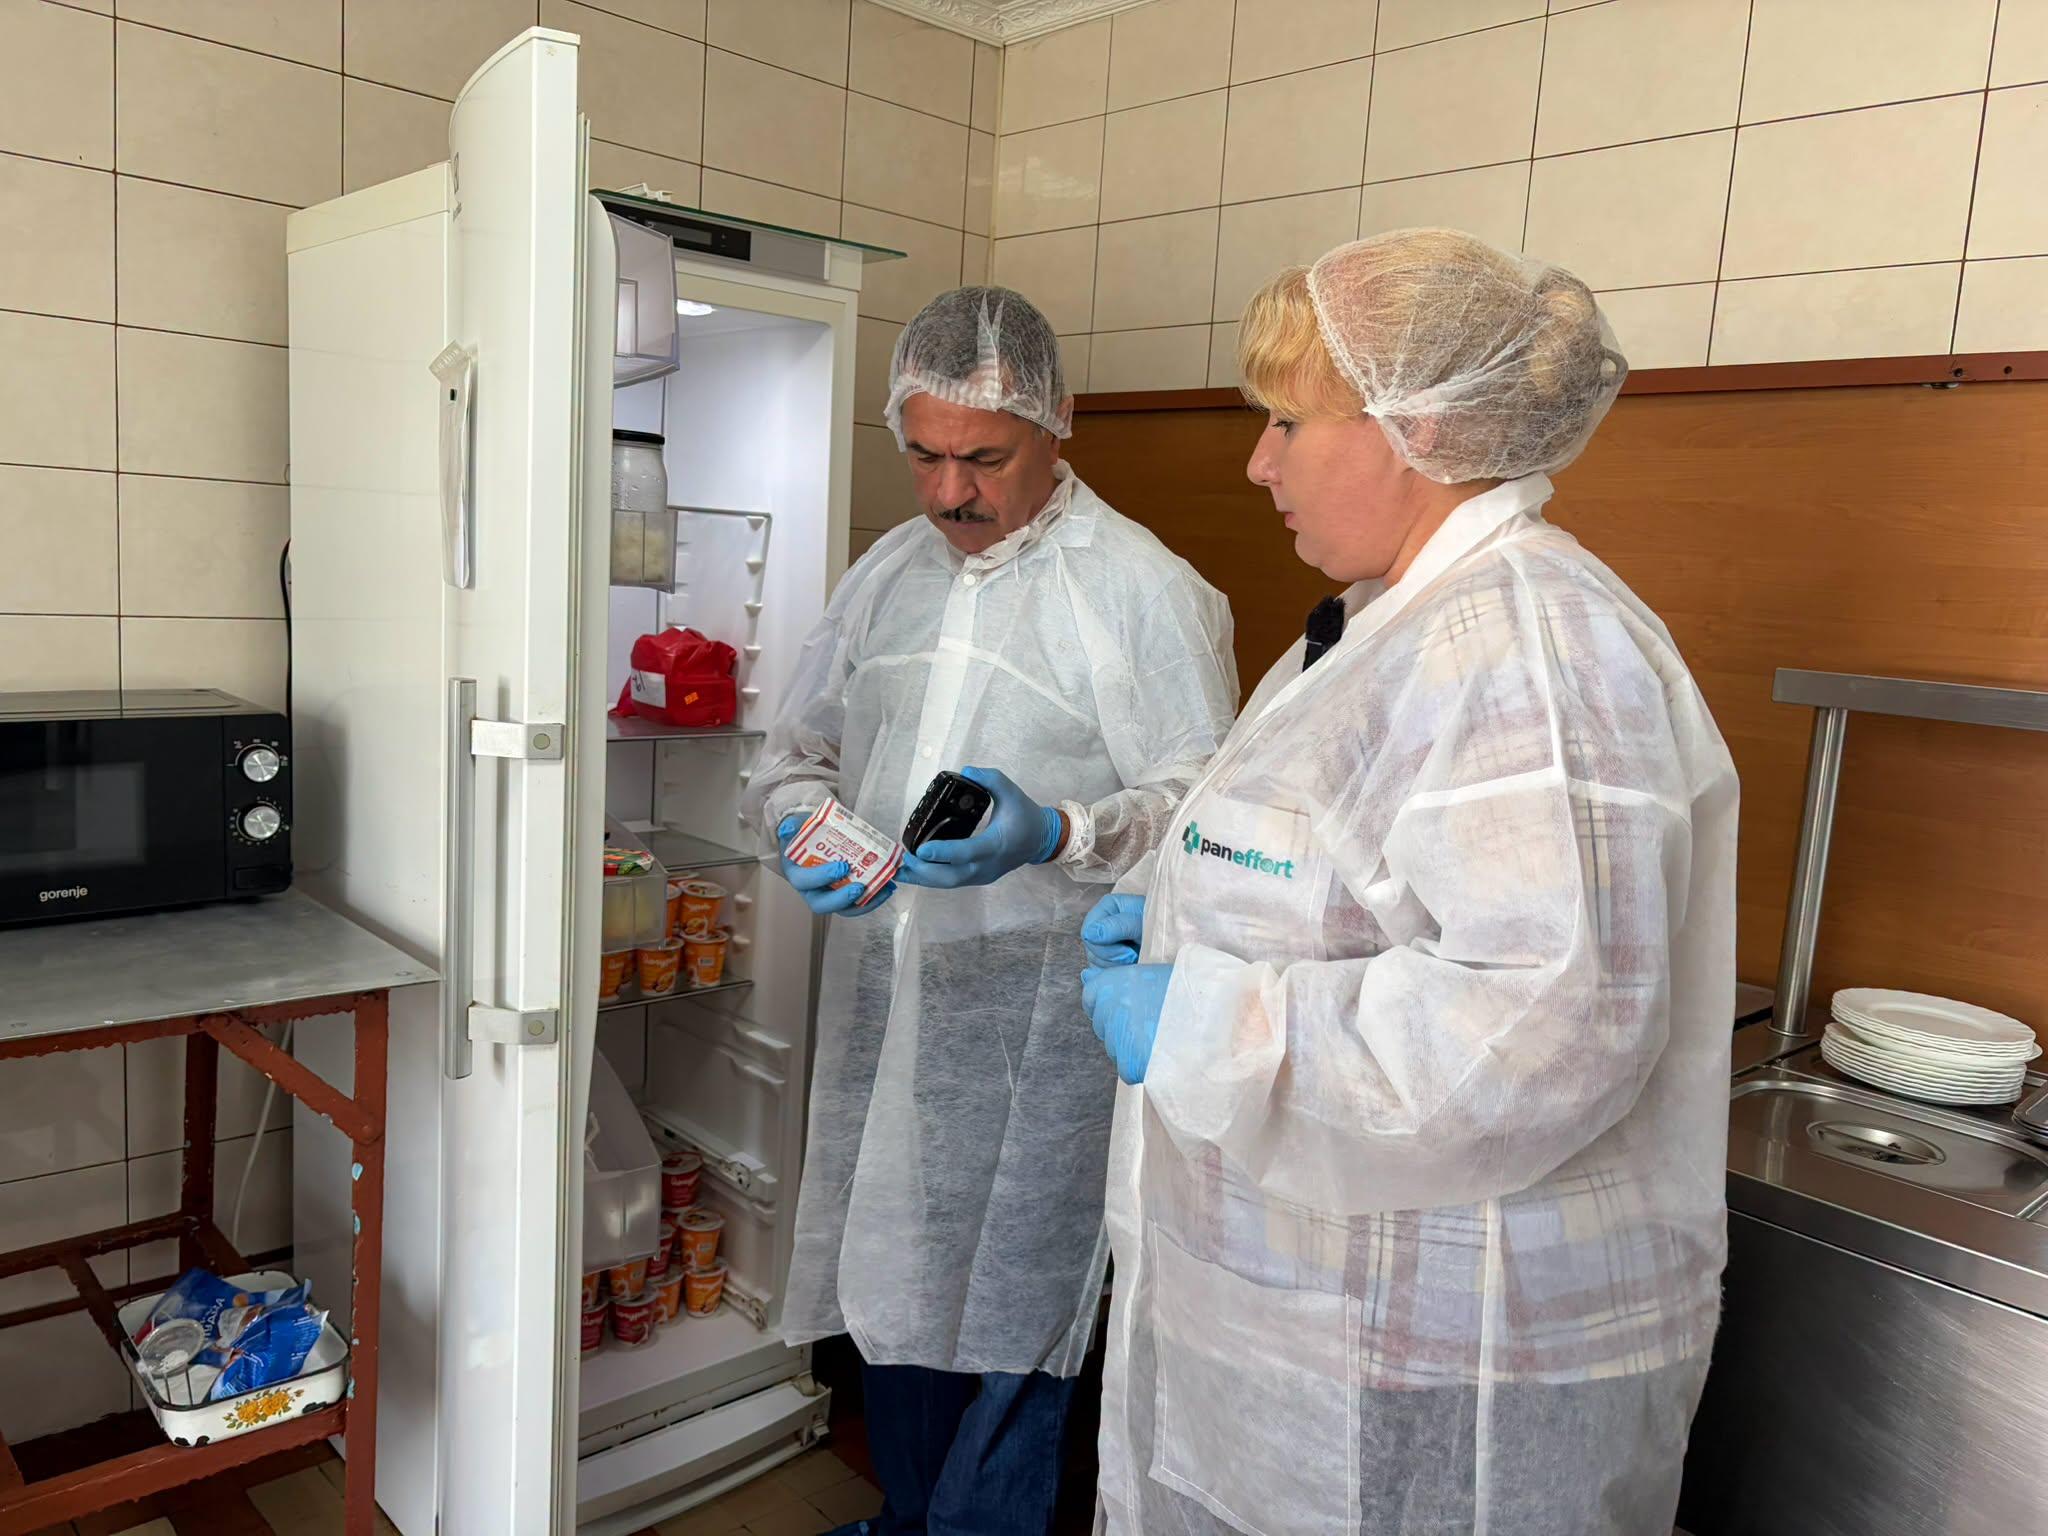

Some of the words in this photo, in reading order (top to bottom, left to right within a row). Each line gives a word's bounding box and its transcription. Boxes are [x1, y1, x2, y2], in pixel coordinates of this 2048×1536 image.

[816, 842, 864, 878] МСЛО
[1200, 838, 1294, 879] paneffort
[39, 885, 89, 903] gorenje
